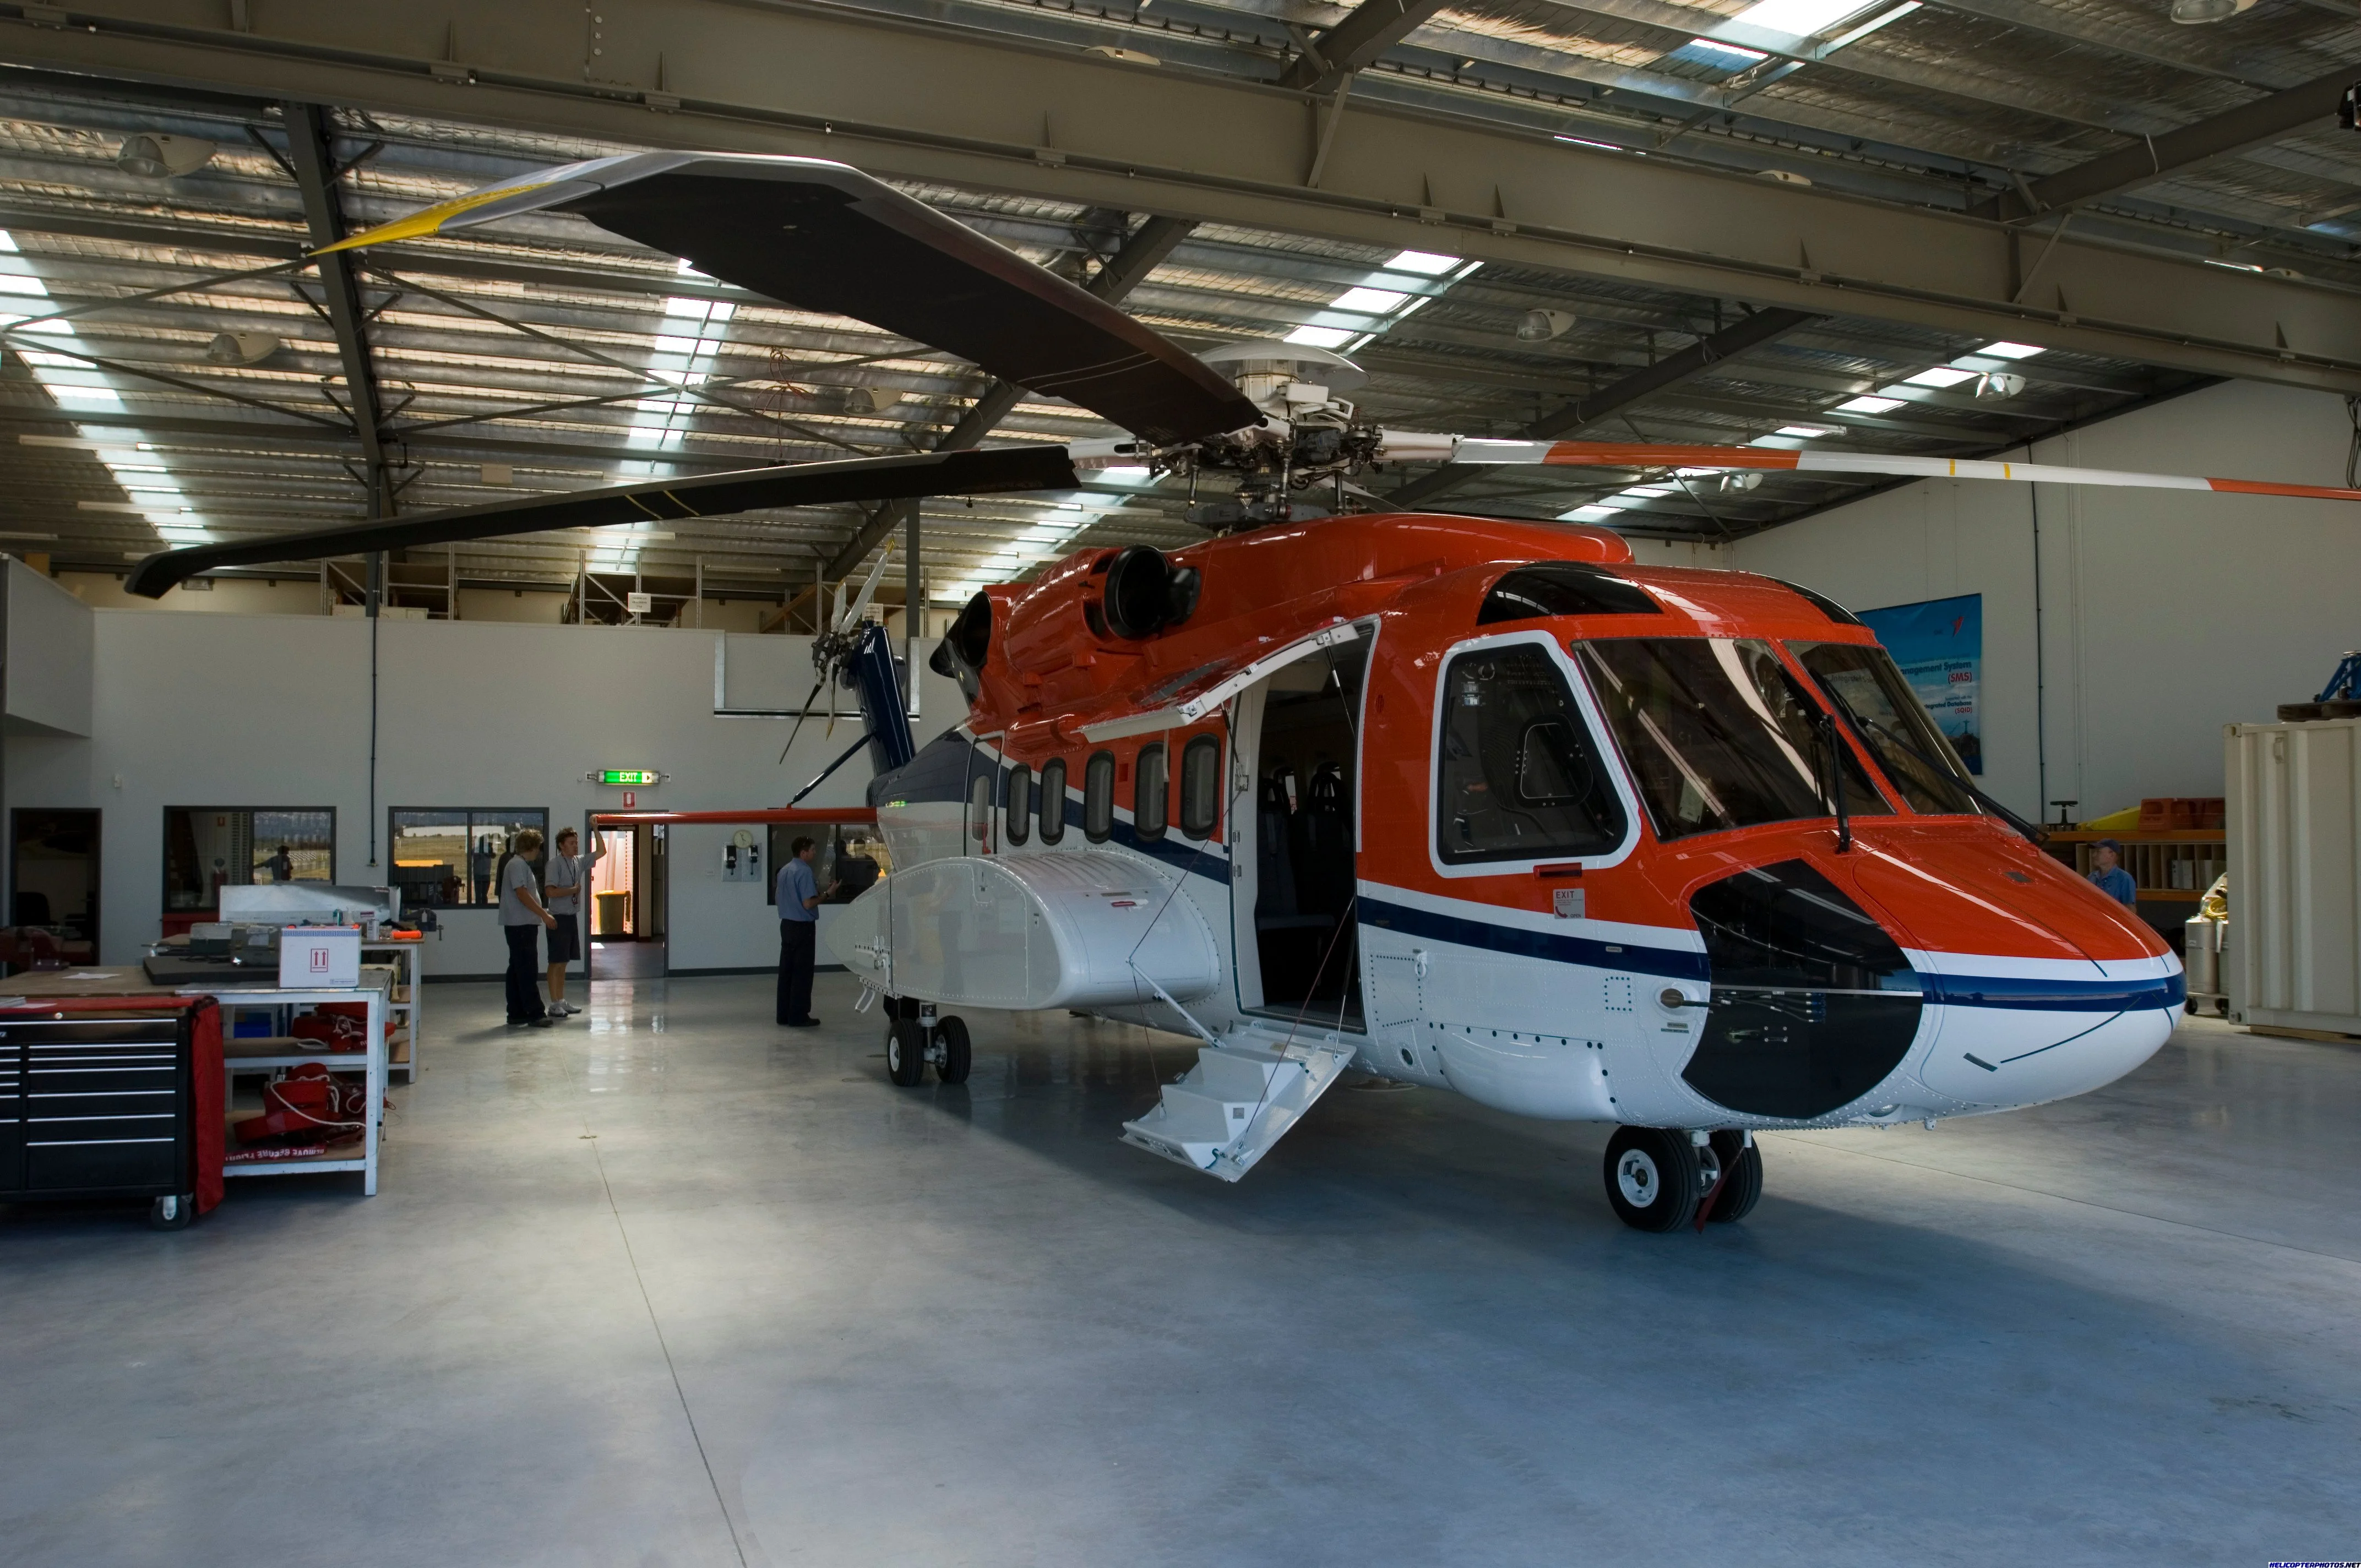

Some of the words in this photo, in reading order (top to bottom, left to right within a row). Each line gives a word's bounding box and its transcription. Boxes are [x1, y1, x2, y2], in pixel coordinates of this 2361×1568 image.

[1901, 663, 1942, 676] anagement
[1944, 661, 1972, 672] System
[1948, 672, 1972, 684] (SMS)
[619, 772, 638, 782] EXIT
[257, 1148, 290, 1158] BEFORE
